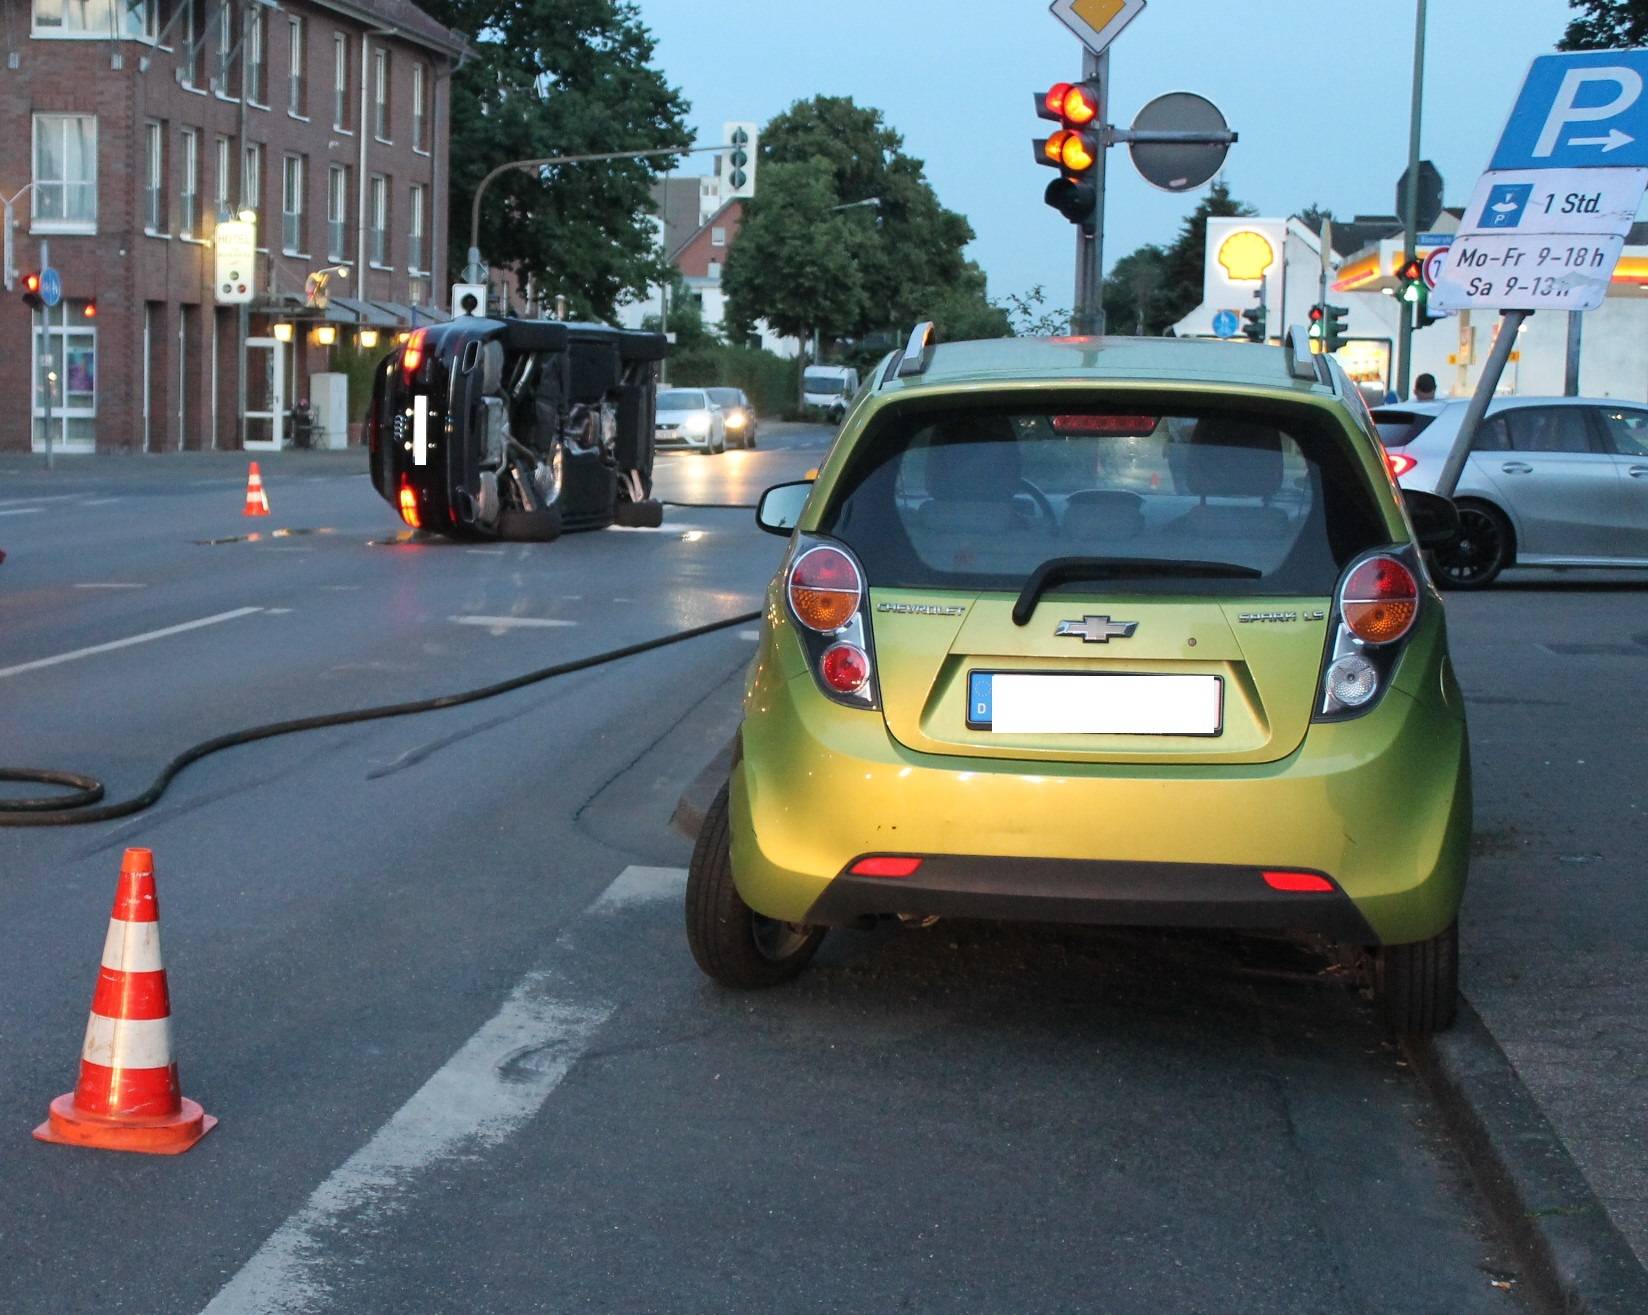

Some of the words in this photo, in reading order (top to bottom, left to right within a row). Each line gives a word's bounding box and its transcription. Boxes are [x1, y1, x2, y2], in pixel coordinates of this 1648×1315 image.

[1531, 66, 1643, 157] P
[1544, 193, 1556, 214] 1
[1561, 192, 1602, 214] Std.
[1456, 247, 1526, 267] Mo-Fr
[1466, 277, 1493, 296] Sa
[877, 602, 966, 616] CHEVROLET
[1238, 611, 1296, 623] SPARK
[1303, 610, 1324, 621] LS
[977, 702, 986, 714] D
